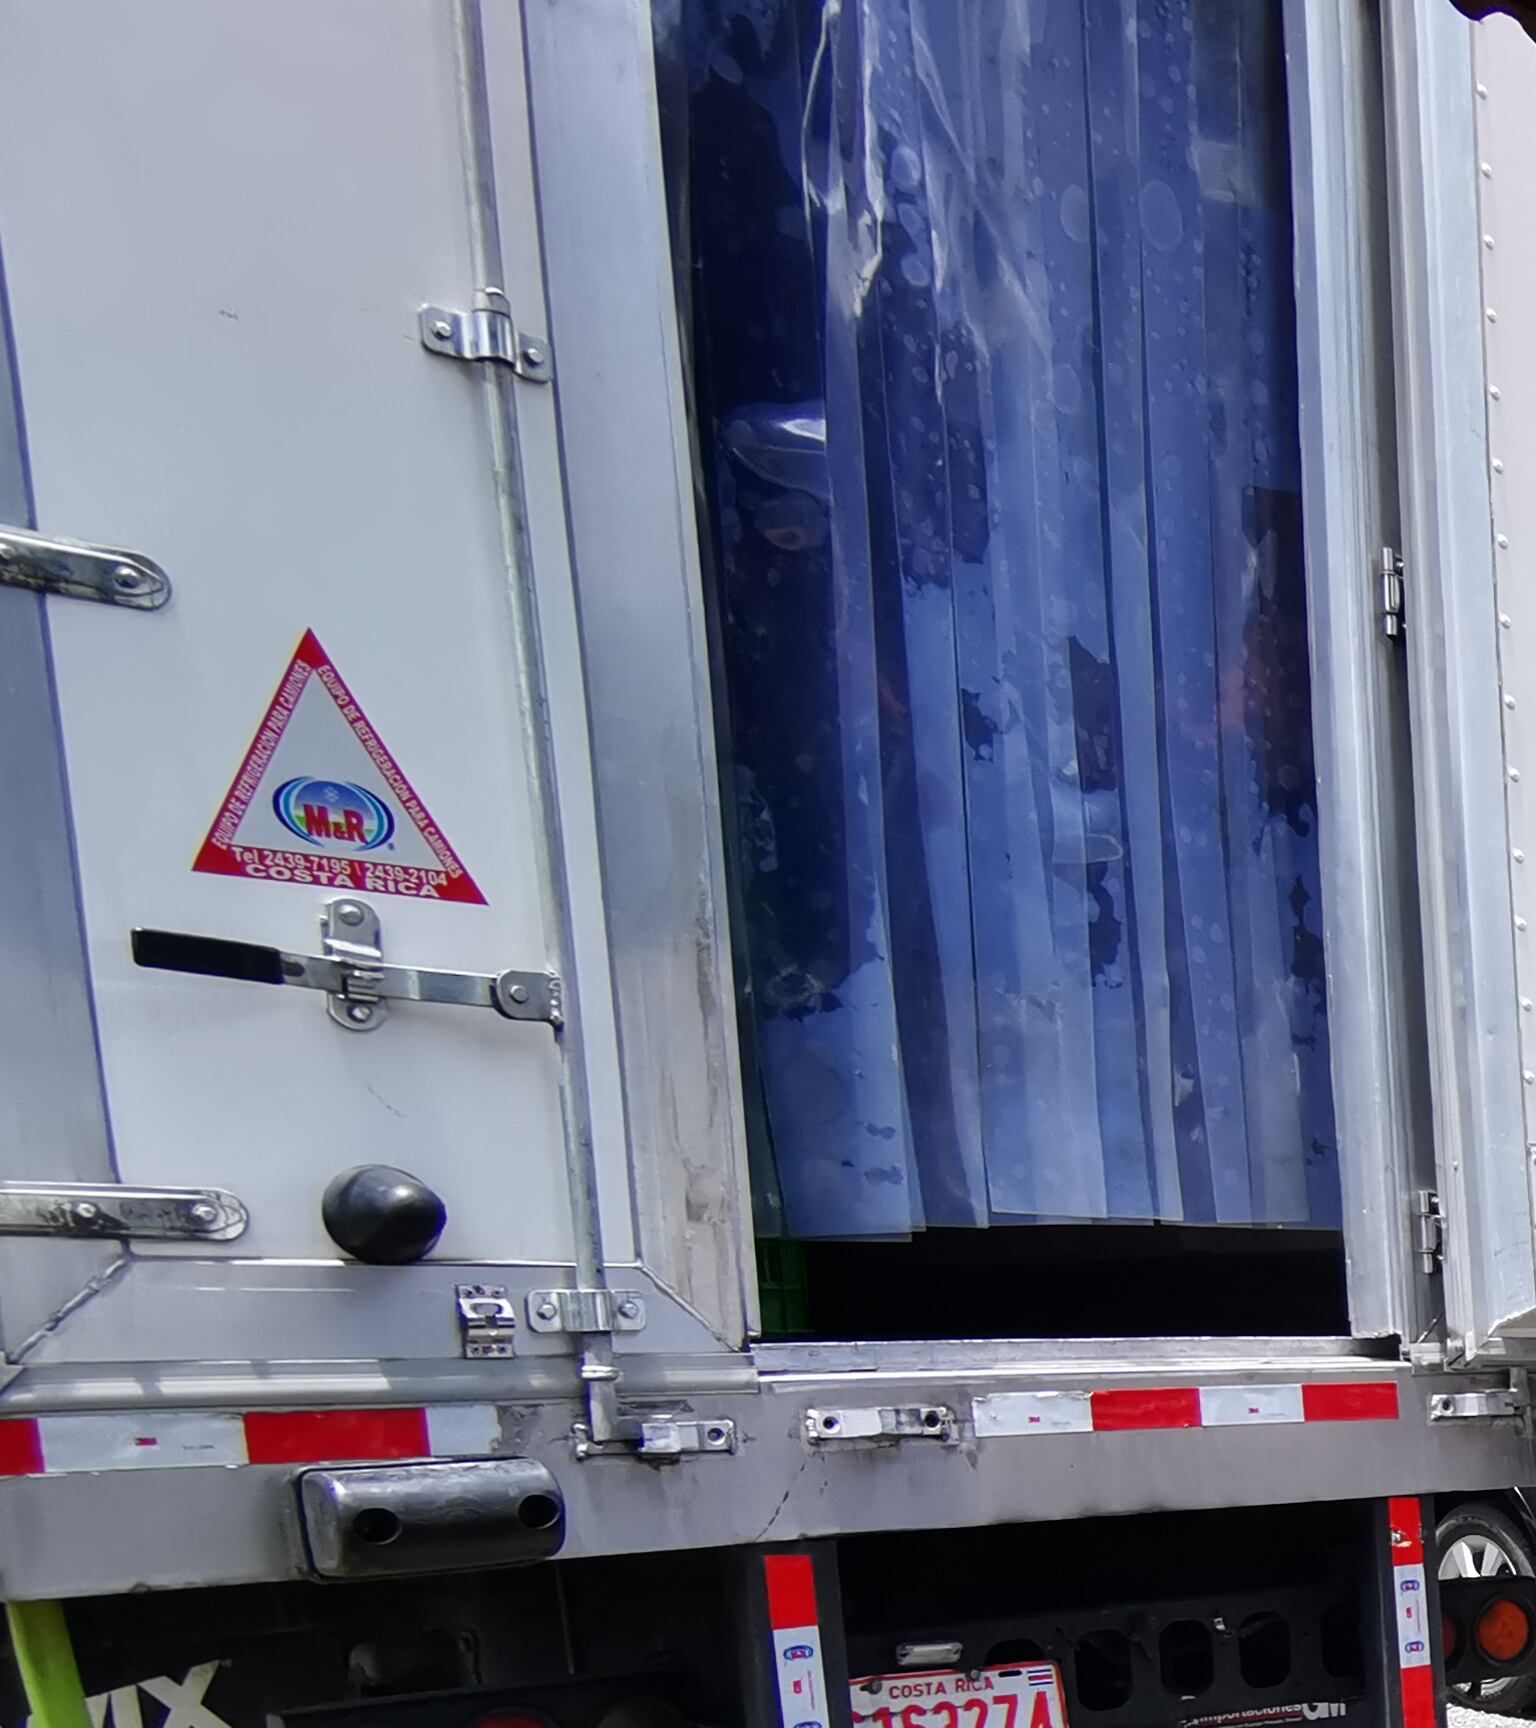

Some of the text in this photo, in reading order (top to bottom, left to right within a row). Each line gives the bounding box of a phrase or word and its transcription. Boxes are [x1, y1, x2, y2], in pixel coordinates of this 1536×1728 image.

[302, 803, 370, 846] M&R
[231, 846, 260, 865] Tel
[263, 850, 352, 876] 2439-7195
[364, 863, 449, 887] 2439-2104
[245, 863, 441, 899] COSTA RICA
[888, 1676, 996, 1700] COSTA RICA
